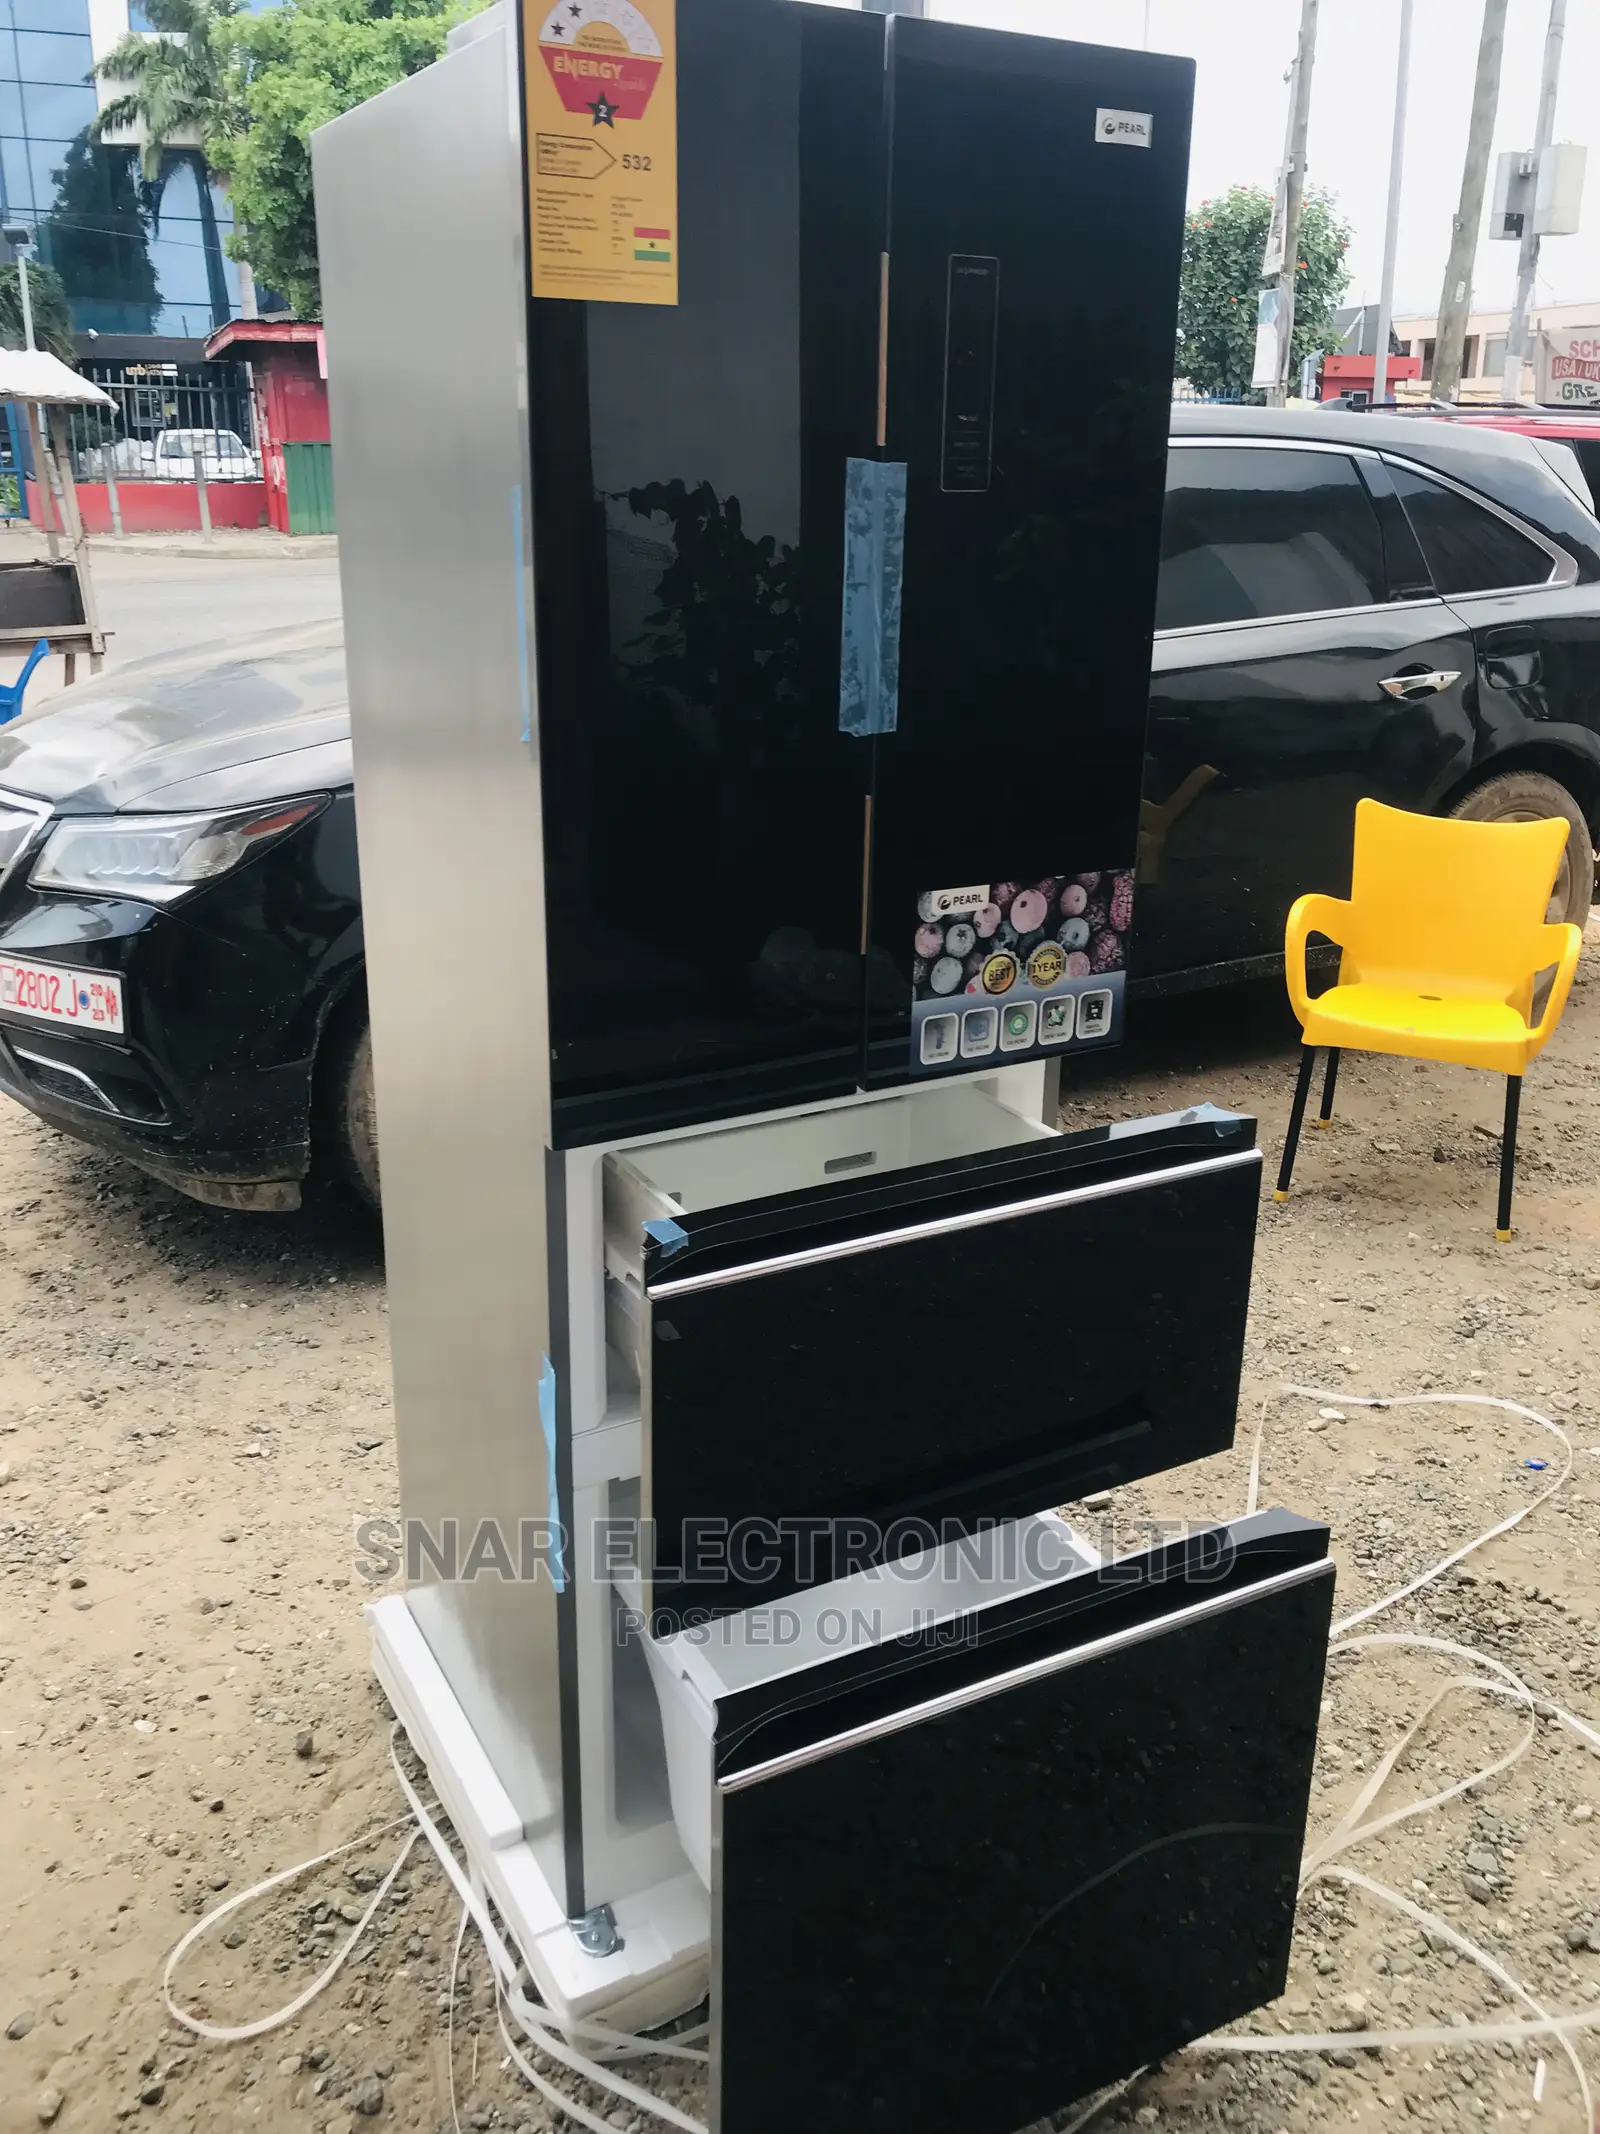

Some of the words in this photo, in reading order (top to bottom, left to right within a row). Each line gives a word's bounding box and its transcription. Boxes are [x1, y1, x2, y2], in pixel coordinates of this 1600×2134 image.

[553, 51, 624, 81] ENERGY
[598, 104, 608, 118] 2
[1118, 121, 1146, 136] PEARL
[622, 153, 652, 172] 532
[953, 894, 984, 906] PEARL
[988, 966, 1011, 982] BEST
[1037, 961, 1062, 973] YEAR
[16, 968, 62, 1014] 2802
[66, 979, 78, 1017] J
